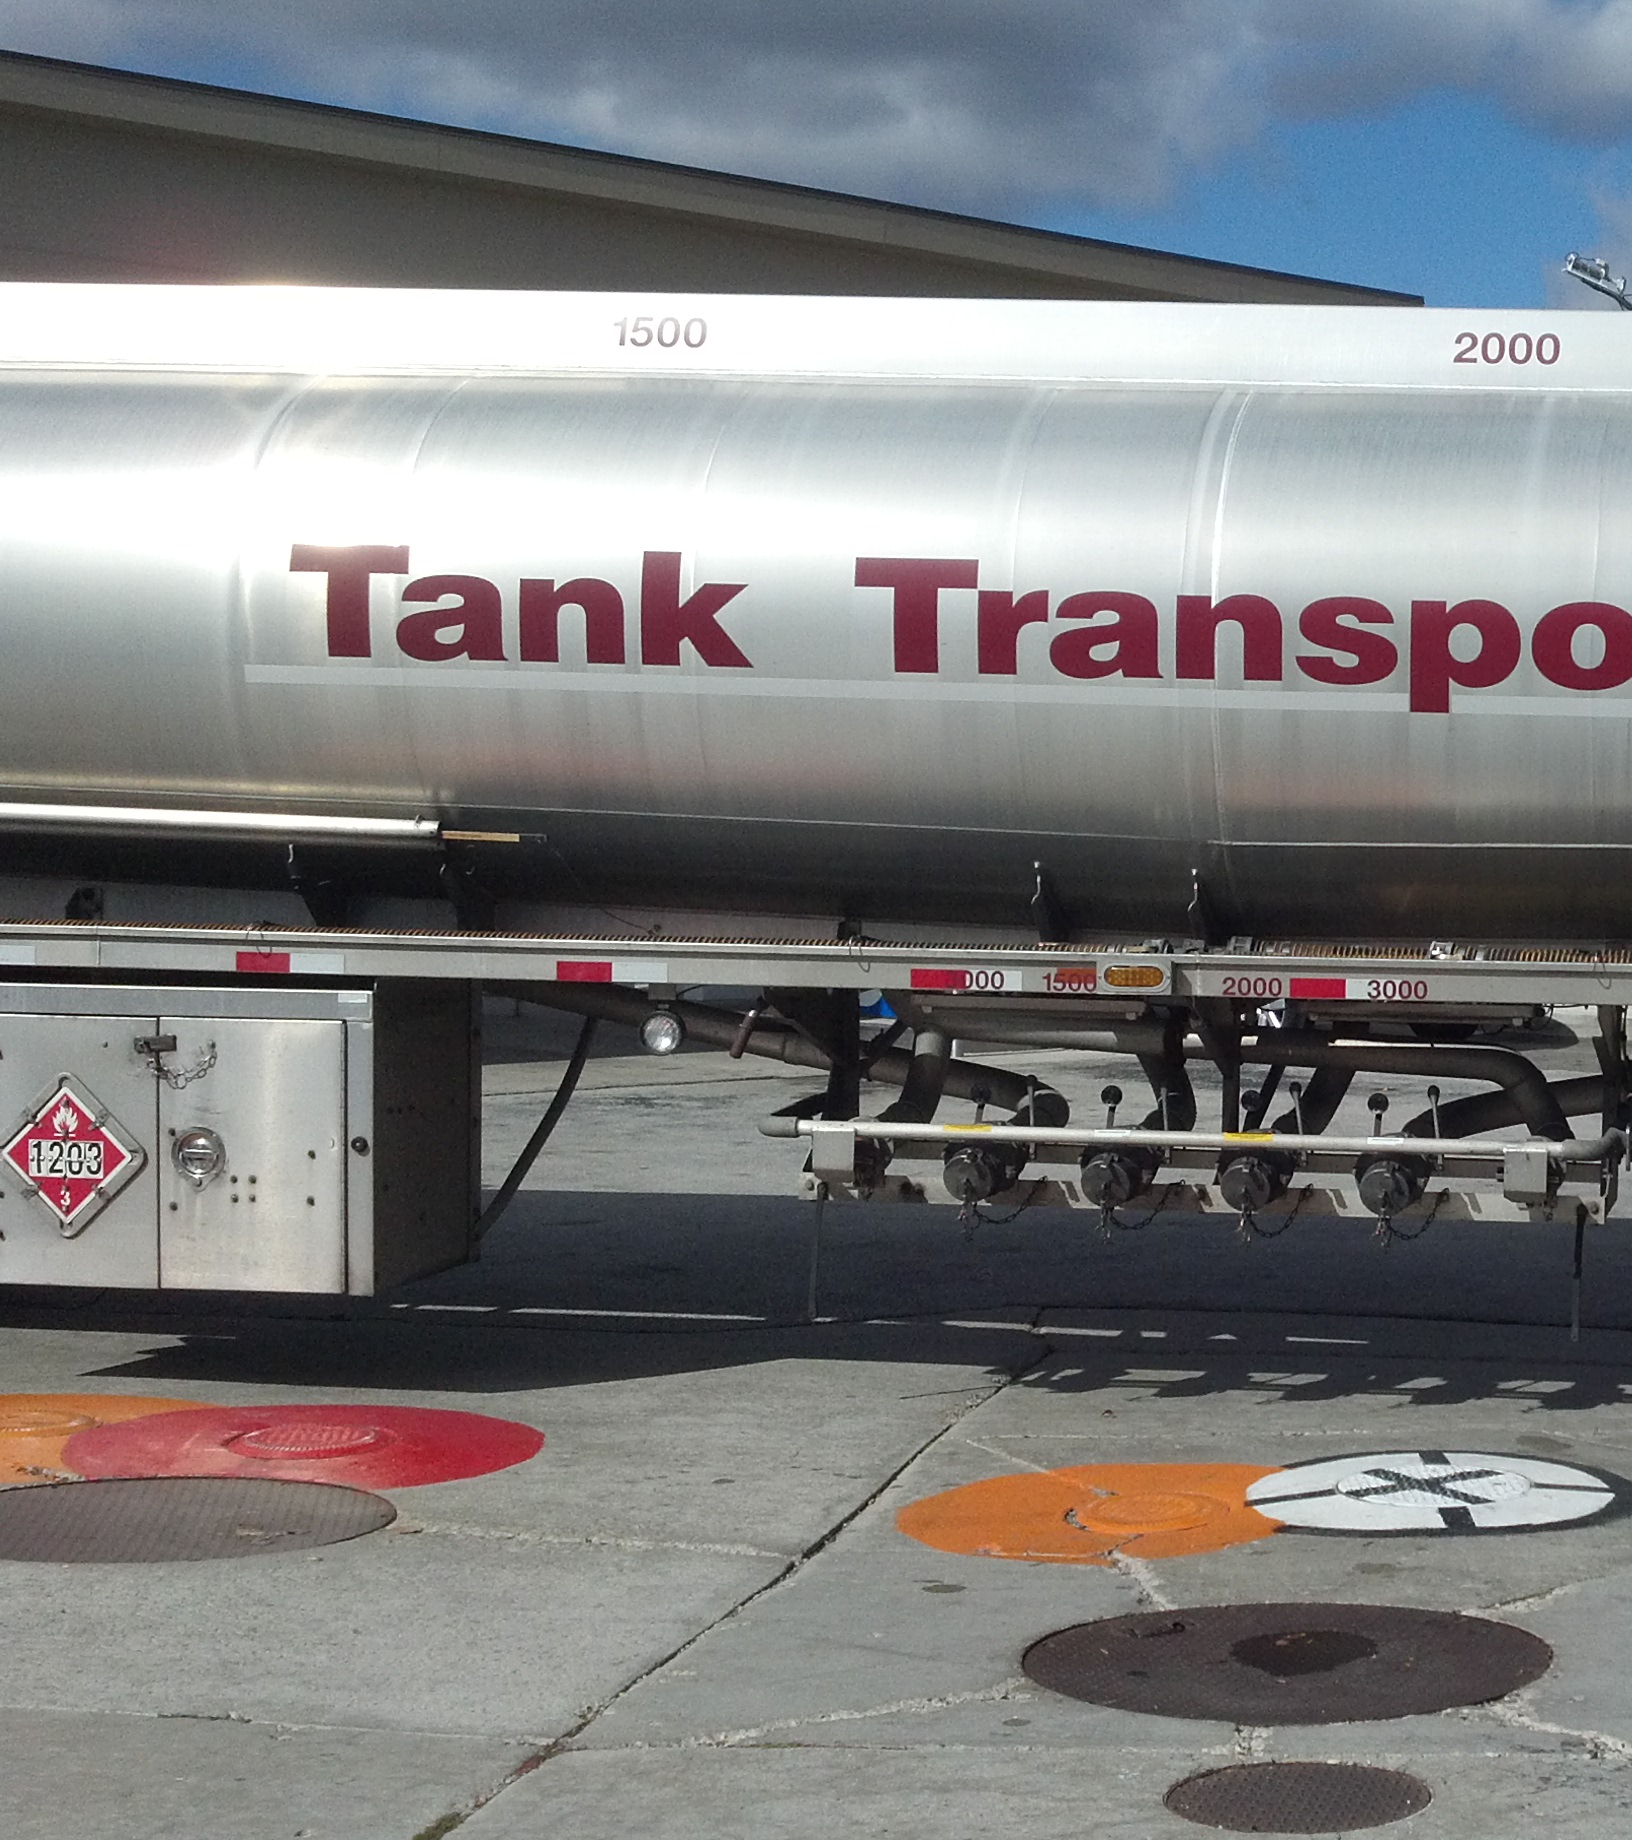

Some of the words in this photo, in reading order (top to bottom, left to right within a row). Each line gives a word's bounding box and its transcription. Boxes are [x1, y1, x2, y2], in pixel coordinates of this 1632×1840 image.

[613, 316, 708, 349] 1500
[1453, 331, 1561, 365] 2000
[289, 543, 754, 669] Tank
[1042, 972, 1098, 992] 1500
[1221, 976, 1283, 997] 2000
[1367, 979, 1428, 1000] 3000
[32, 1140, 102, 1176] 1203
[60, 1190, 71, 1206] 3
